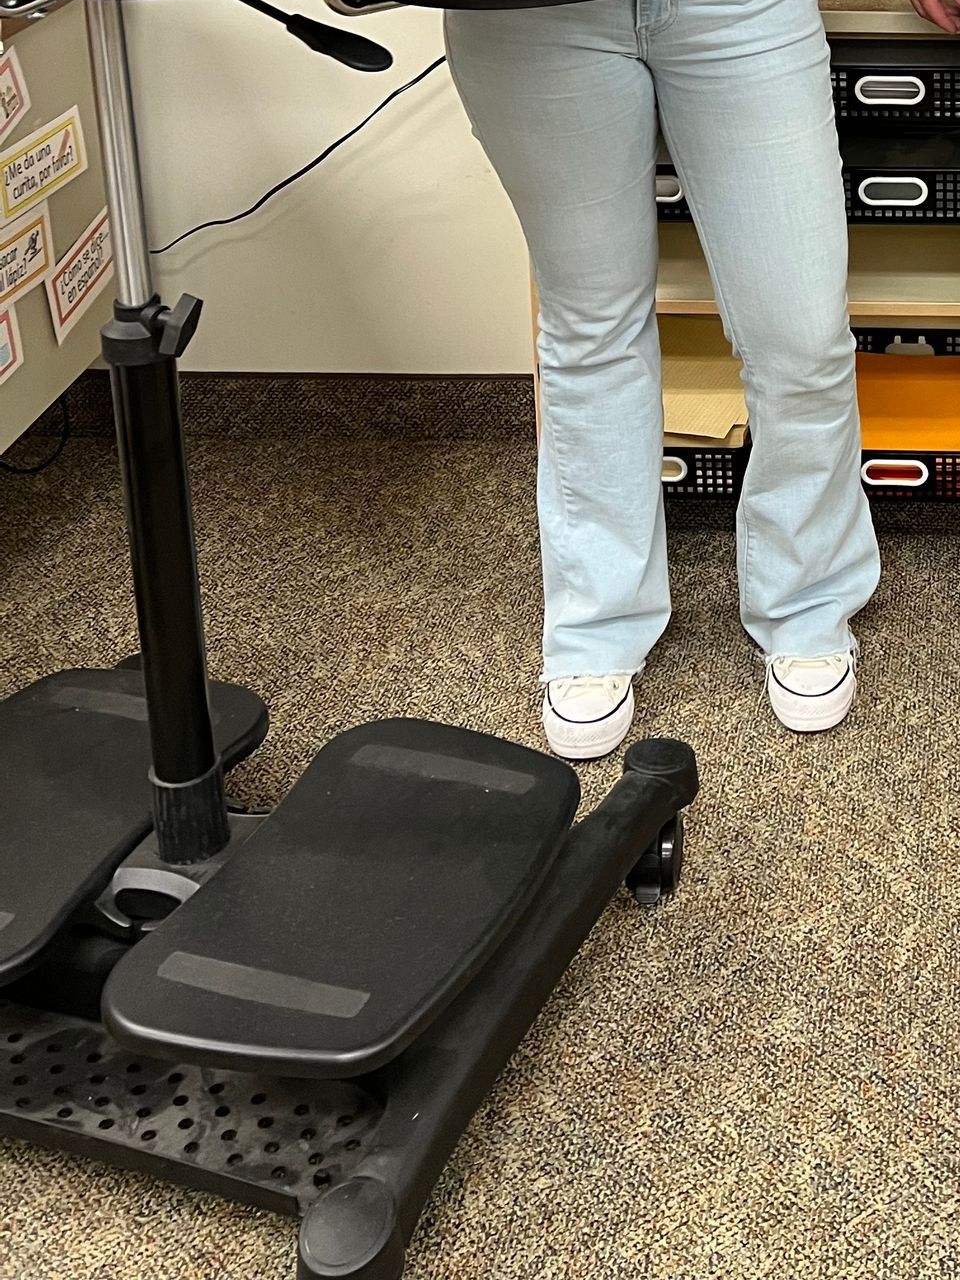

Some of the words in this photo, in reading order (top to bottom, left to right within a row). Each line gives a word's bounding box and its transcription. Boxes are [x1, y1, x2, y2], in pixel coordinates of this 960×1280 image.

[5, 161, 23, 187] ¿Me
[24, 152, 35, 170] da
[35, 144, 52, 162] una
[38, 165, 51, 187] por
[82, 249, 90, 264] se
[67, 286, 78, 304] en
